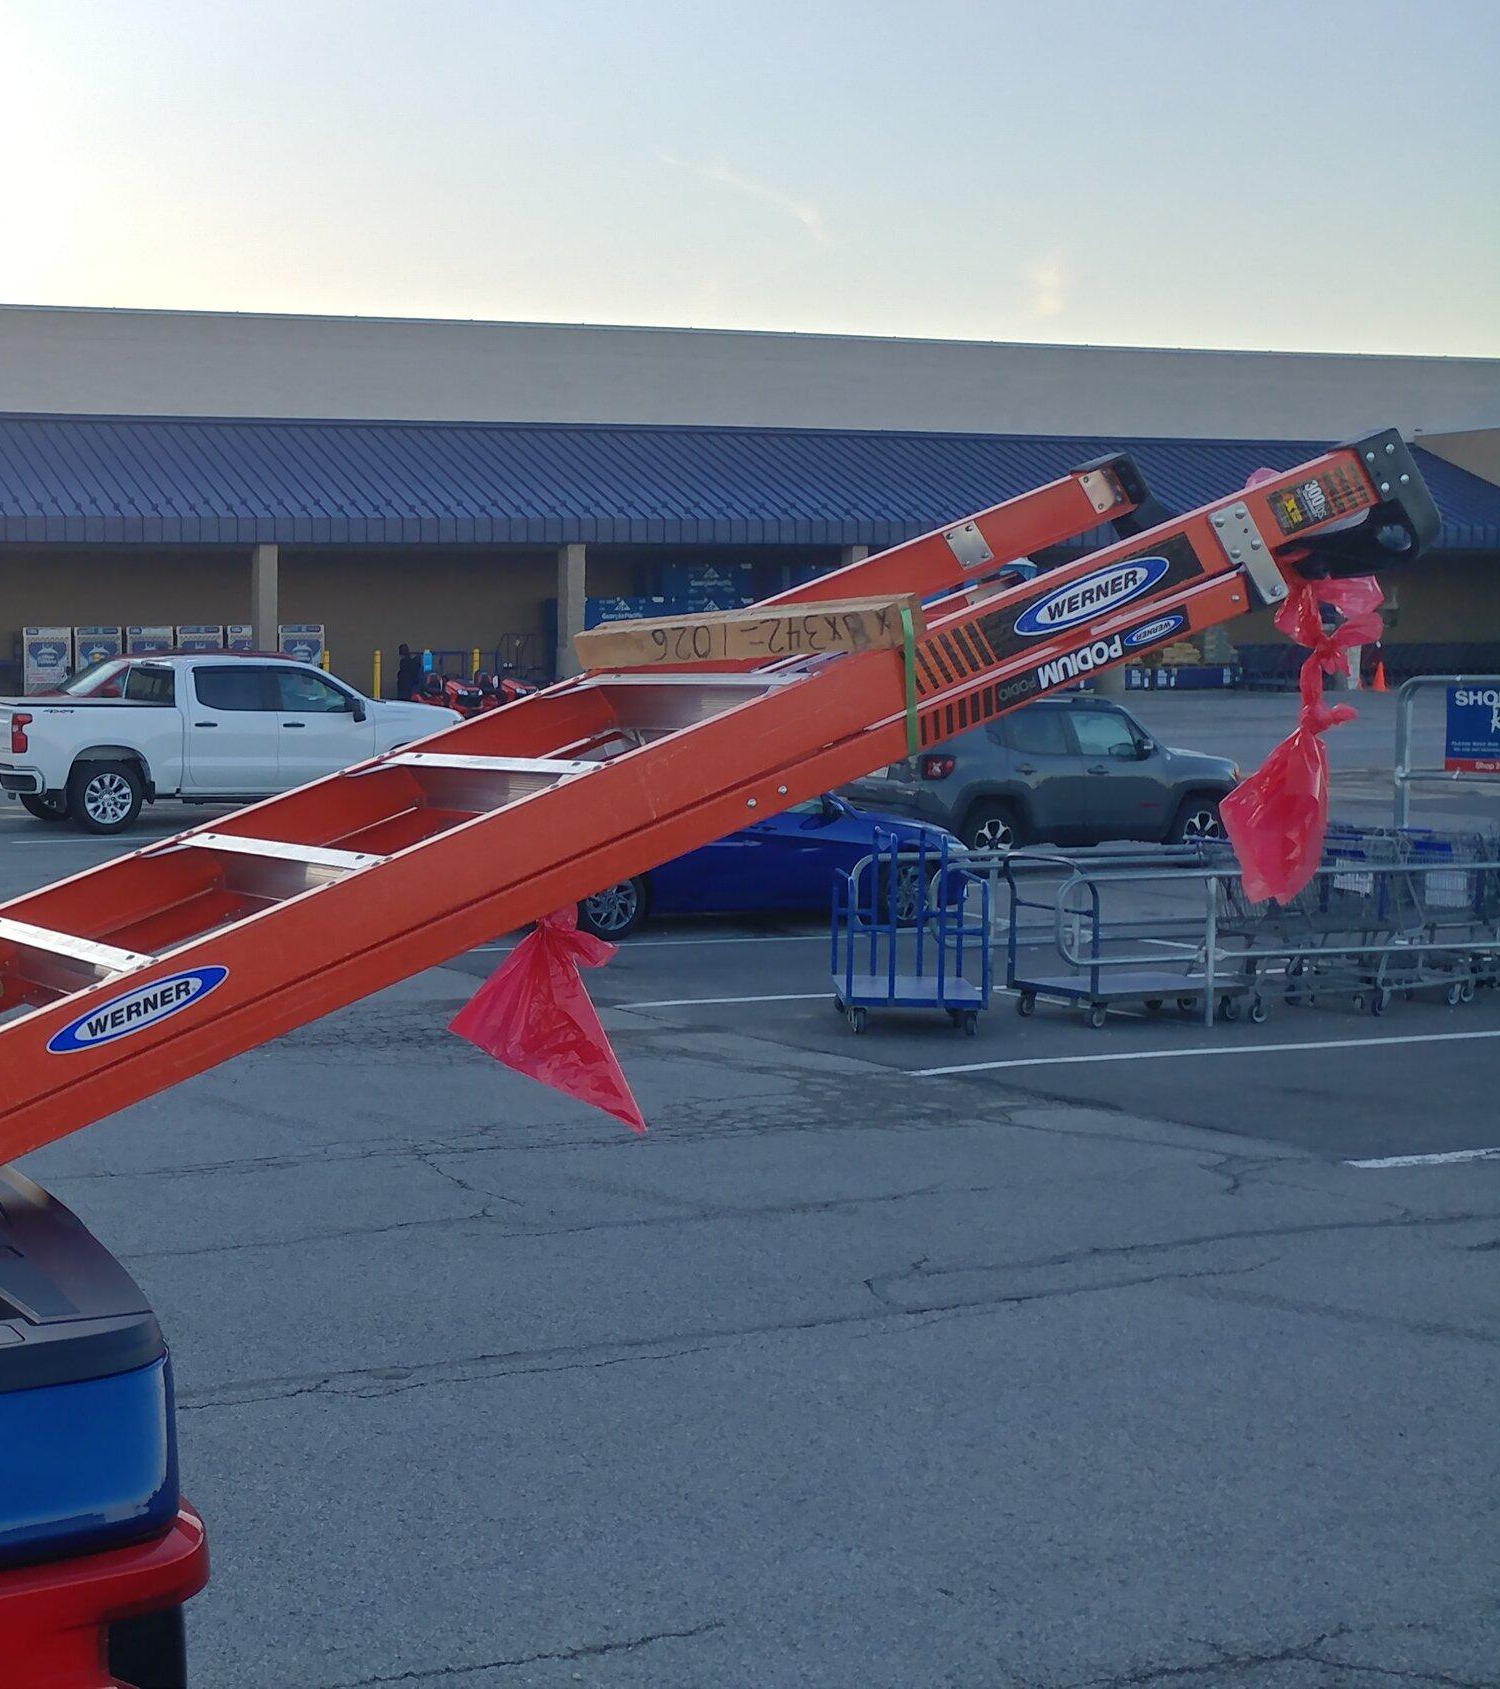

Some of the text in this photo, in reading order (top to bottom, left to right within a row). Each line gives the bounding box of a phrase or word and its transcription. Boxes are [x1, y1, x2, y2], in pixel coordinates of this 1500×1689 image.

[1047, 570, 1138, 621] WERNER
[1135, 620, 1172, 642] WERNER
[1037, 634, 1124, 690] PODIUM
[1455, 690, 1500, 707] SHO
[86, 980, 191, 1038] WERNER
